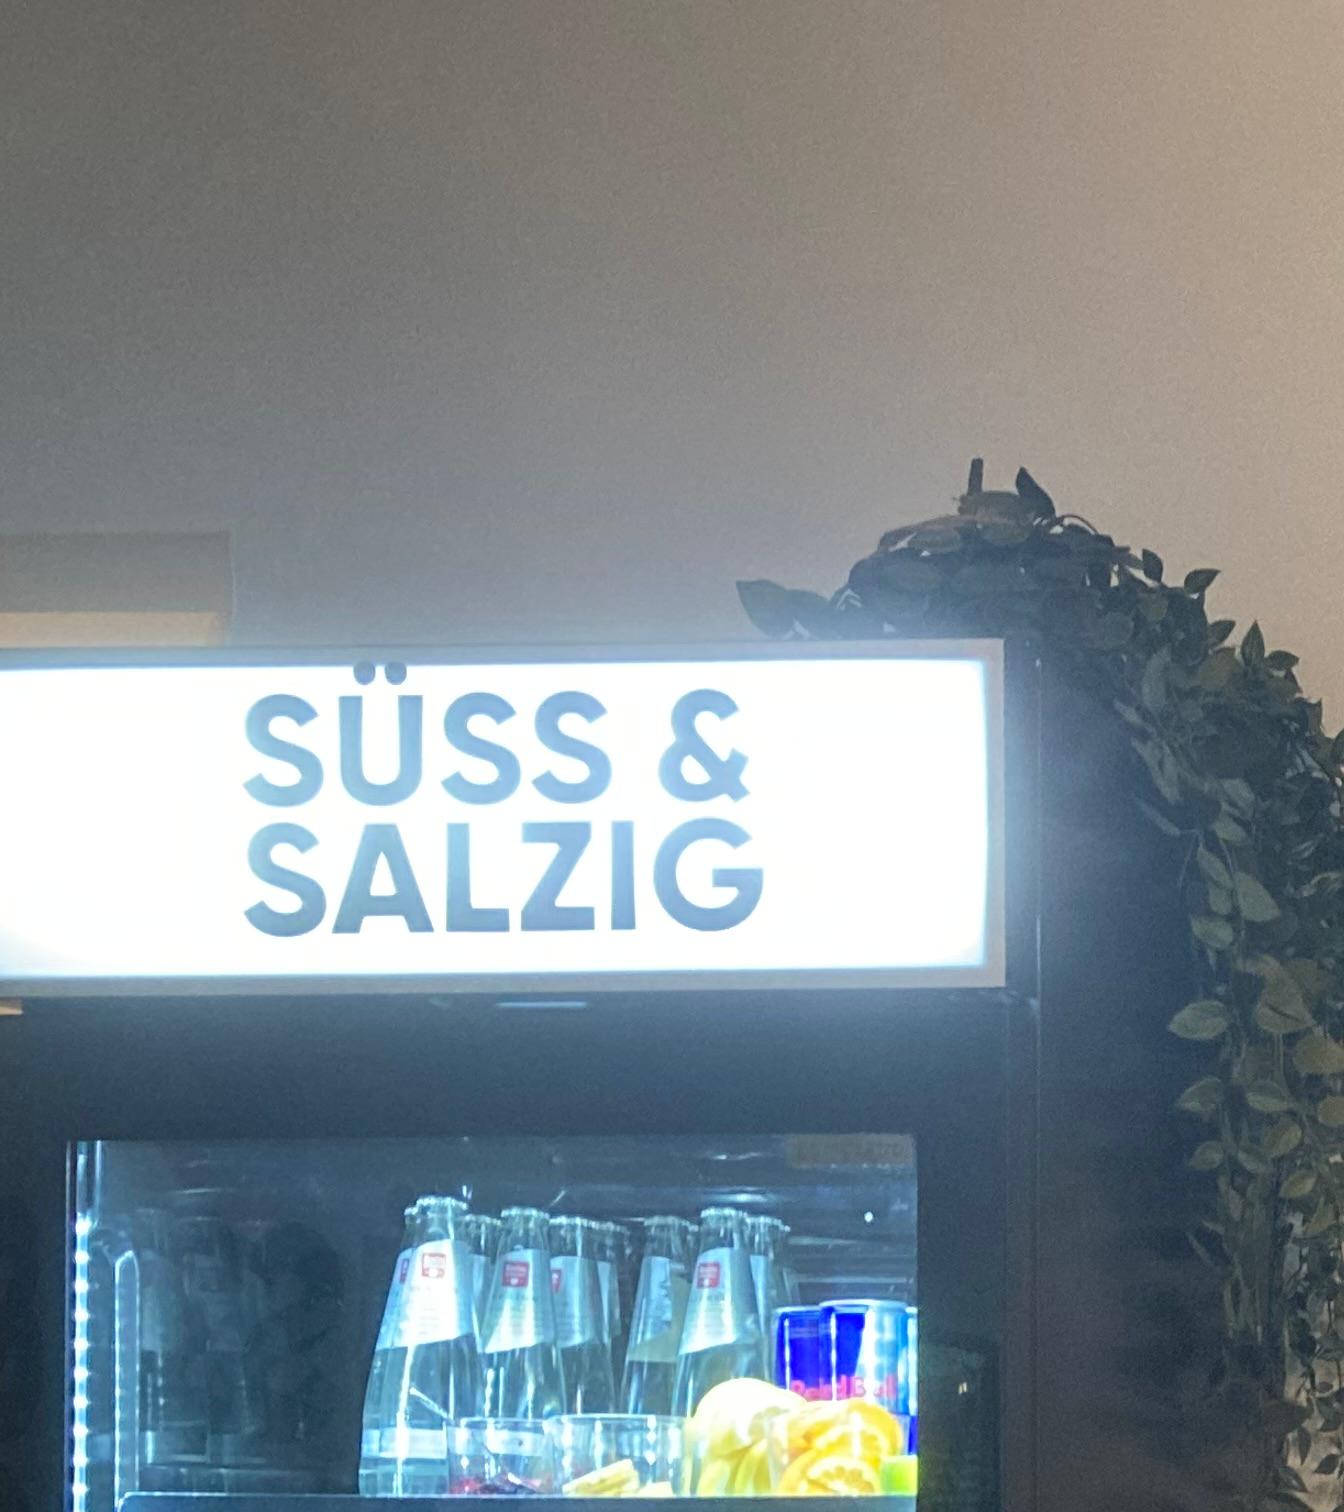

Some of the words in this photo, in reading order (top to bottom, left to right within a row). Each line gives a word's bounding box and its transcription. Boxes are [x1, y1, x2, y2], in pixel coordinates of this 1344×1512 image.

[242, 661, 612, 807] SÜSS
[658, 689, 750, 803] &
[244, 817, 764, 938] SALZIG
